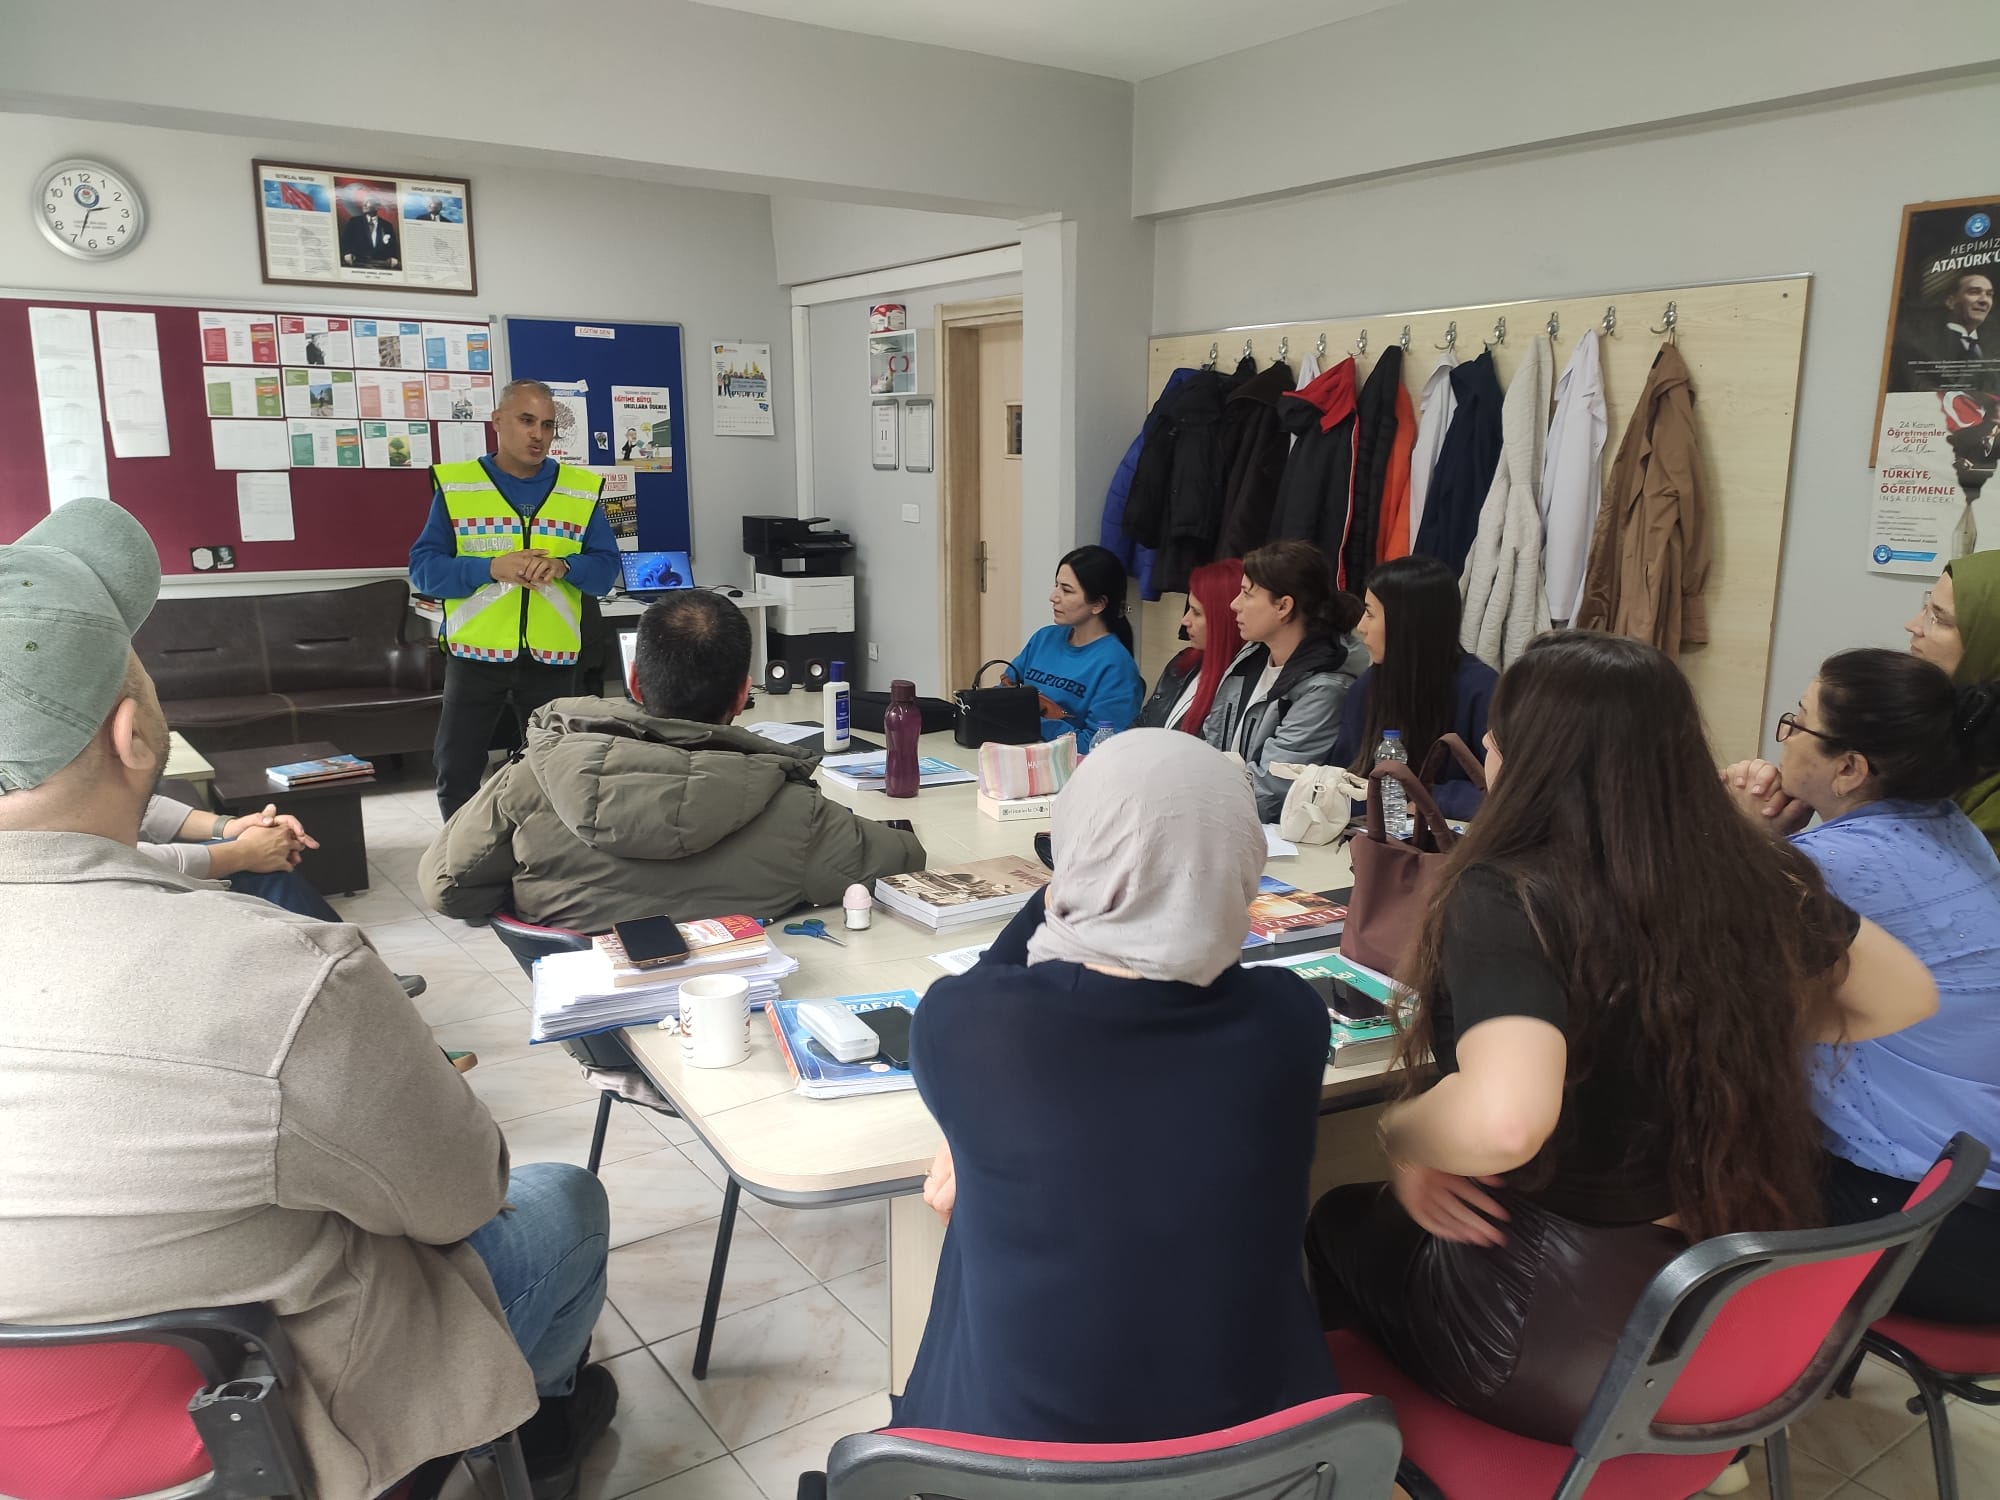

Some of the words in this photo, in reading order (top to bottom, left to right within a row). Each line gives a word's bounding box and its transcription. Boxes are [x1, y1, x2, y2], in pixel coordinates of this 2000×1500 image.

[62, 176, 72, 187] 11
[78, 173, 91, 184] 12
[101, 179, 106, 189] 1
[50, 188, 63, 198] 10
[112, 191, 122, 202] 2
[46, 203, 56, 213] 9
[121, 209, 130, 219] 3
[55, 220, 64, 230] 8
[117, 224, 126, 234] 4
[70, 233, 78, 244] 7
[106, 235, 115, 245] 5
[88, 239, 98, 249] 6
[1887, 427, 1946, 438] Öğretmenler
[1903, 436, 1928, 444] Günü
[1880, 483, 1956, 496] ÖĞRETMENLE
[845, 1000, 906, 1012] RAFYA
